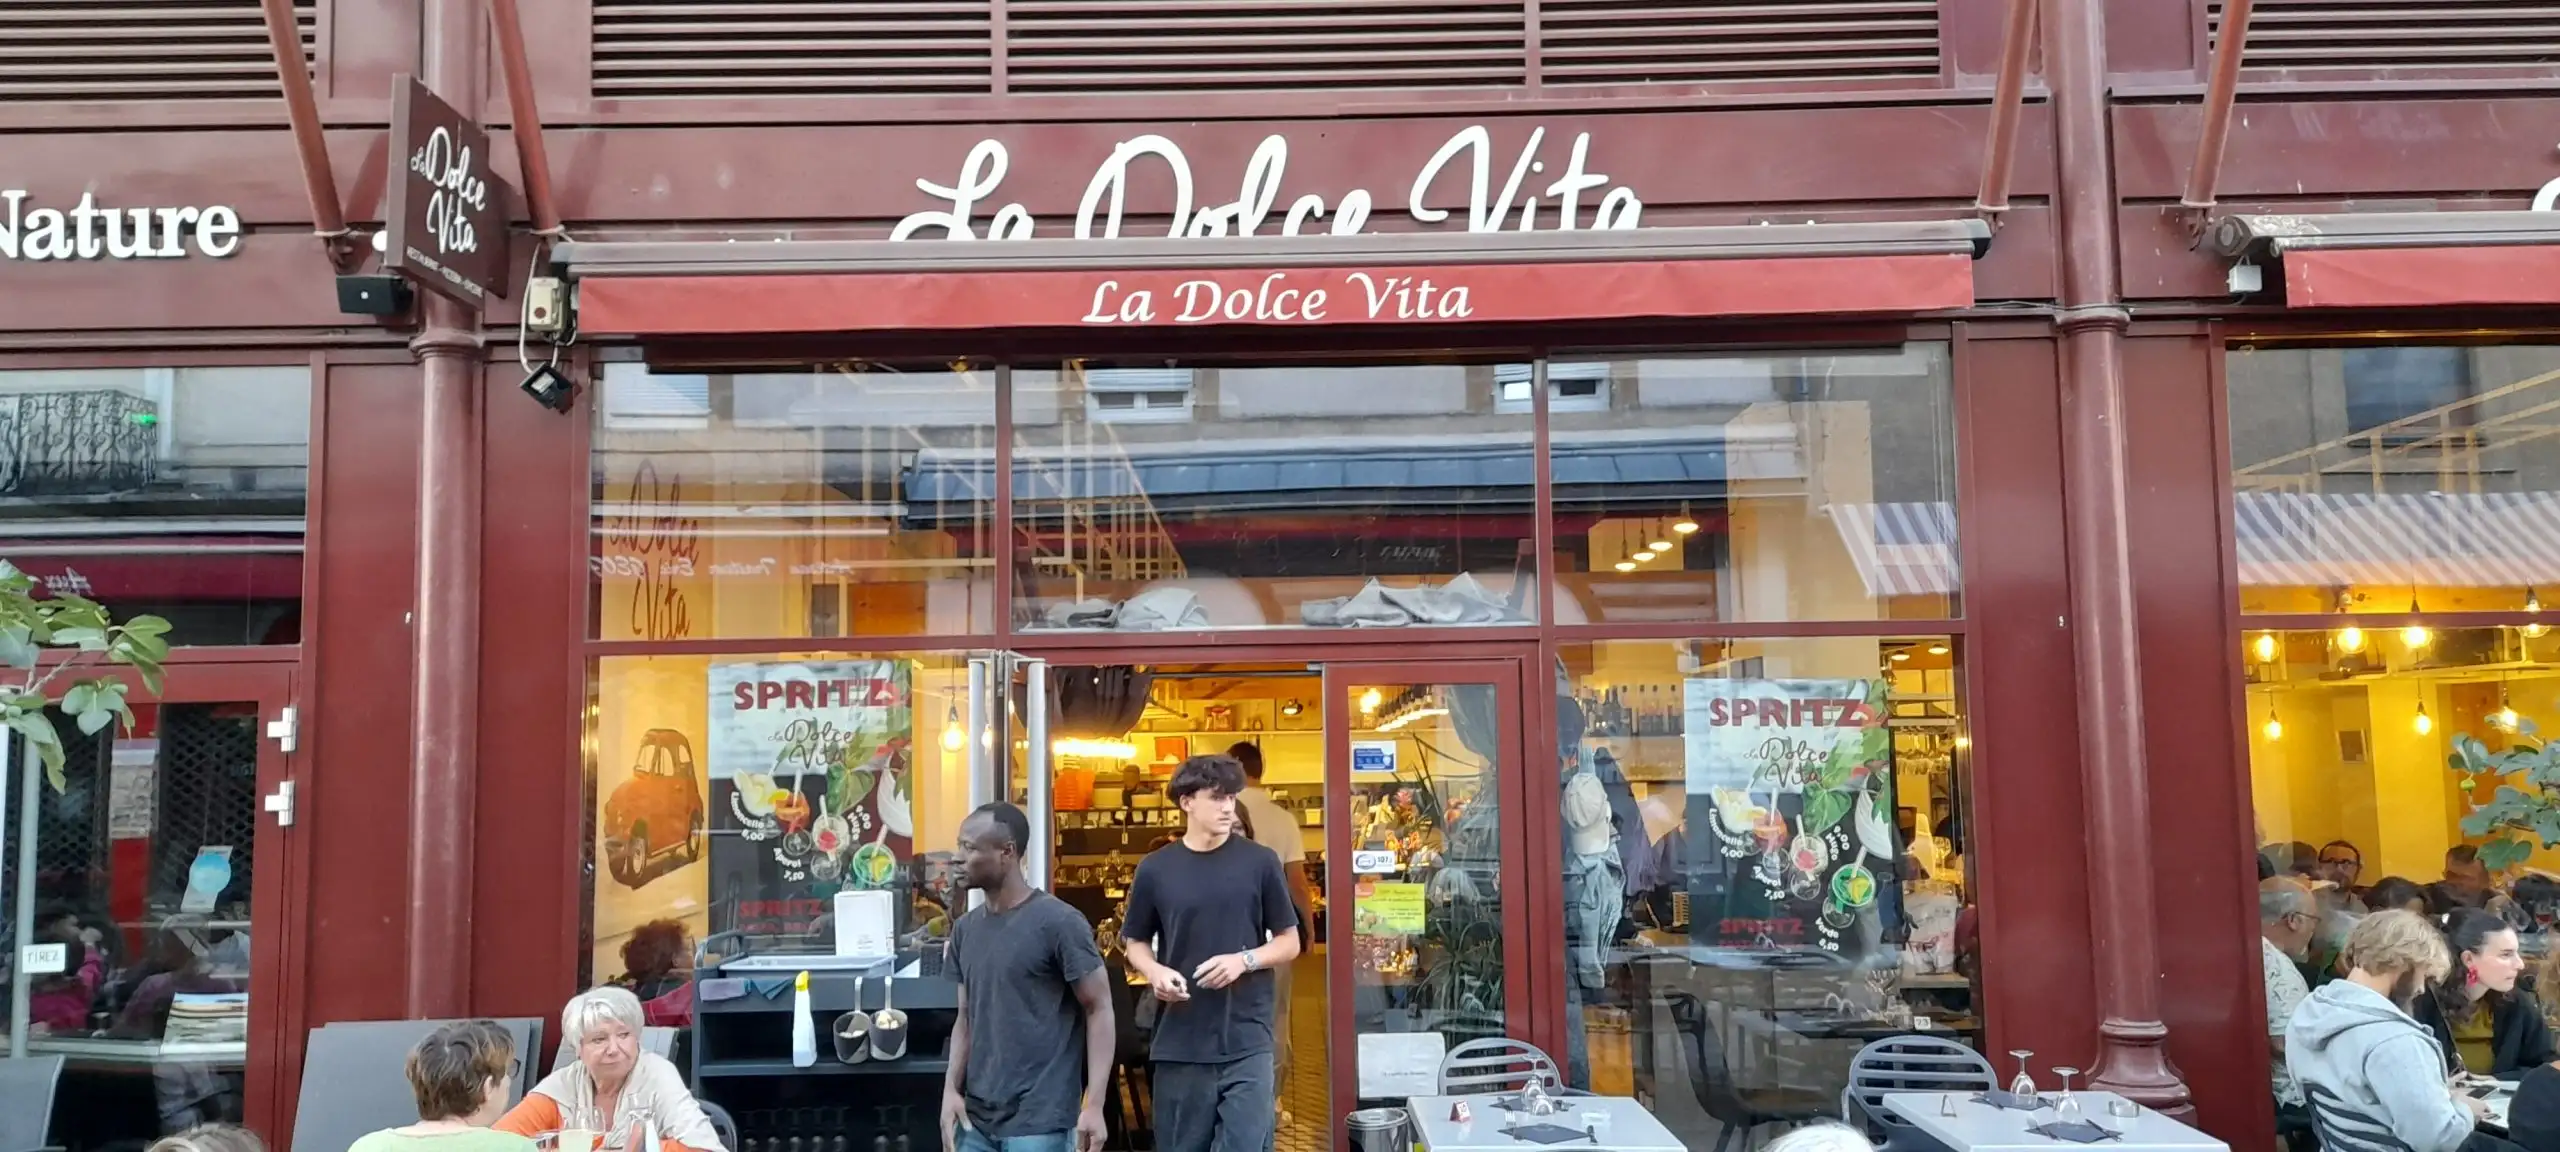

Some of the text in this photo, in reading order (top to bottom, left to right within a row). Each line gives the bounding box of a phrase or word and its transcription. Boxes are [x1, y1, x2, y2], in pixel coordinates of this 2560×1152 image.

[425, 125, 486, 212] Dolce
[1075, 134, 1375, 240] Dolce
[1409, 125, 1645, 233] Vita
[0, 189, 240, 260] Nature
[426, 188, 478, 254] Vita
[1081, 272, 1474, 323] La Dolce Vita
[734, 678, 889, 711] SPRITZ
[1709, 697, 1863, 729] SPRITZ
[784, 718, 852, 743] Dolce
[789, 741, 847, 770] Vita
[1759, 736, 1829, 763] Dolce
[1764, 762, 1822, 788] Vita
[1752, 865, 1781, 887] Aperol
[1815, 916, 1840, 939] Verde
